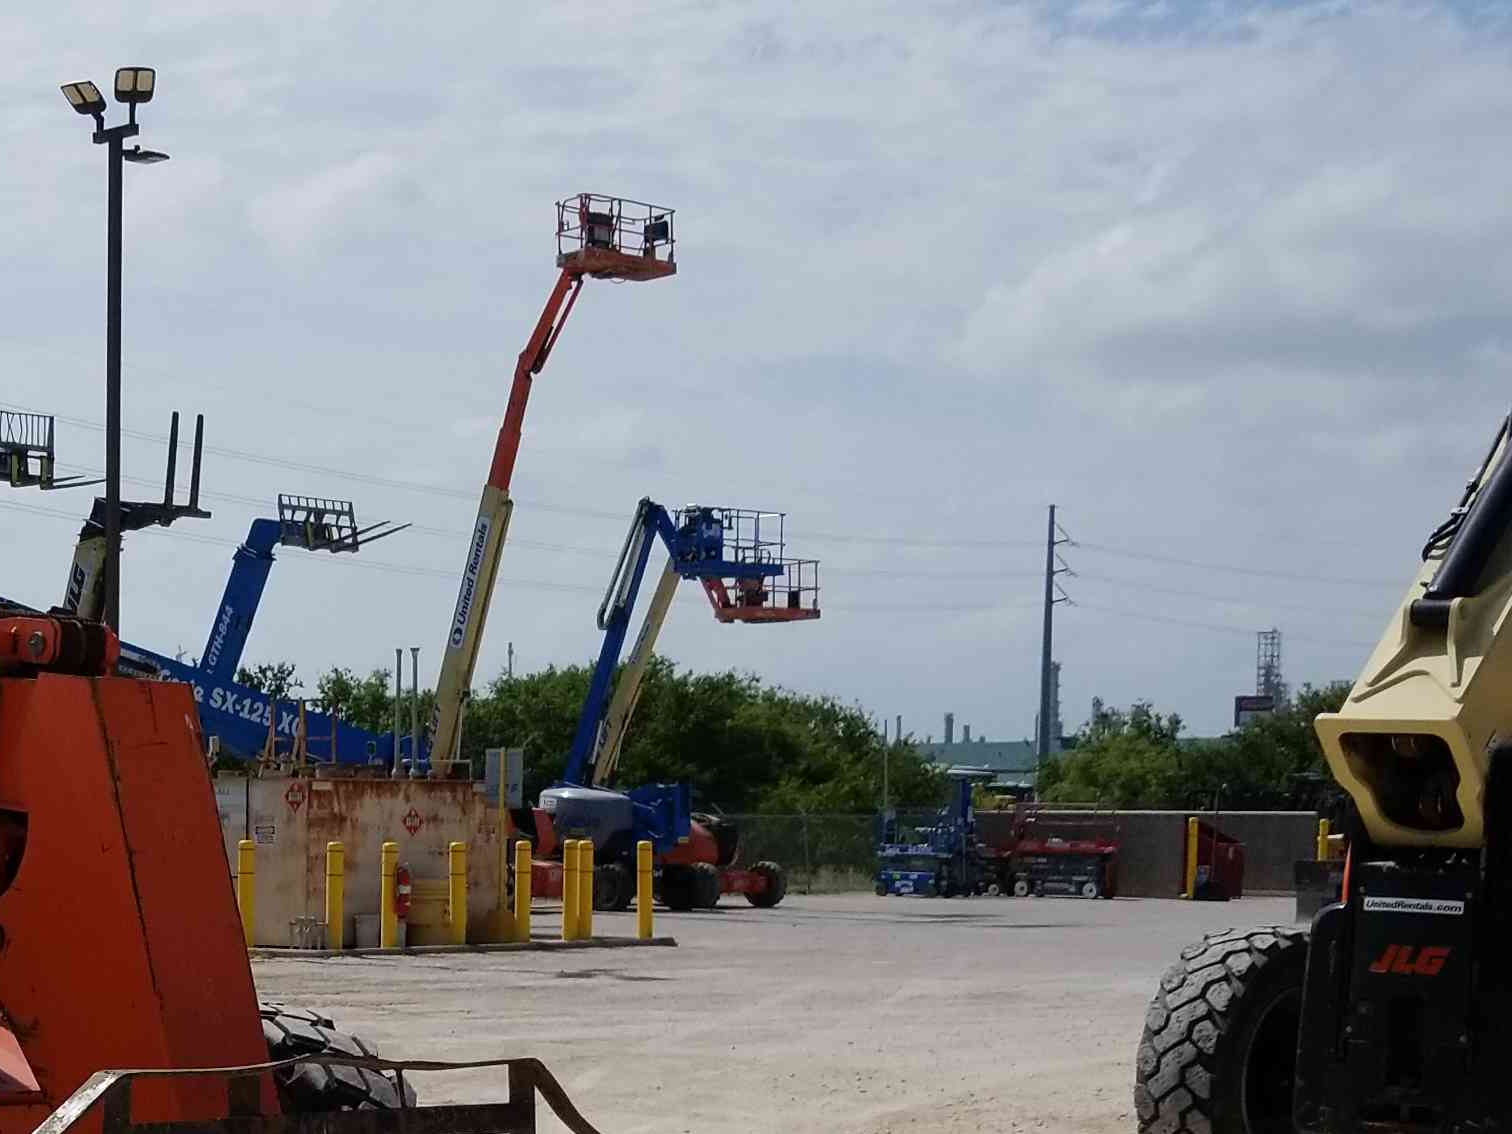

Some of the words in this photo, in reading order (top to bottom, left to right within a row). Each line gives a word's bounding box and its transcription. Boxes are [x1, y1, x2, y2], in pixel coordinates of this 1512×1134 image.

[457, 578, 474, 625] United
[469, 523, 488, 576] Rentals
[208, 686, 273, 727] SX-125
[1368, 943, 1452, 976] JLG
